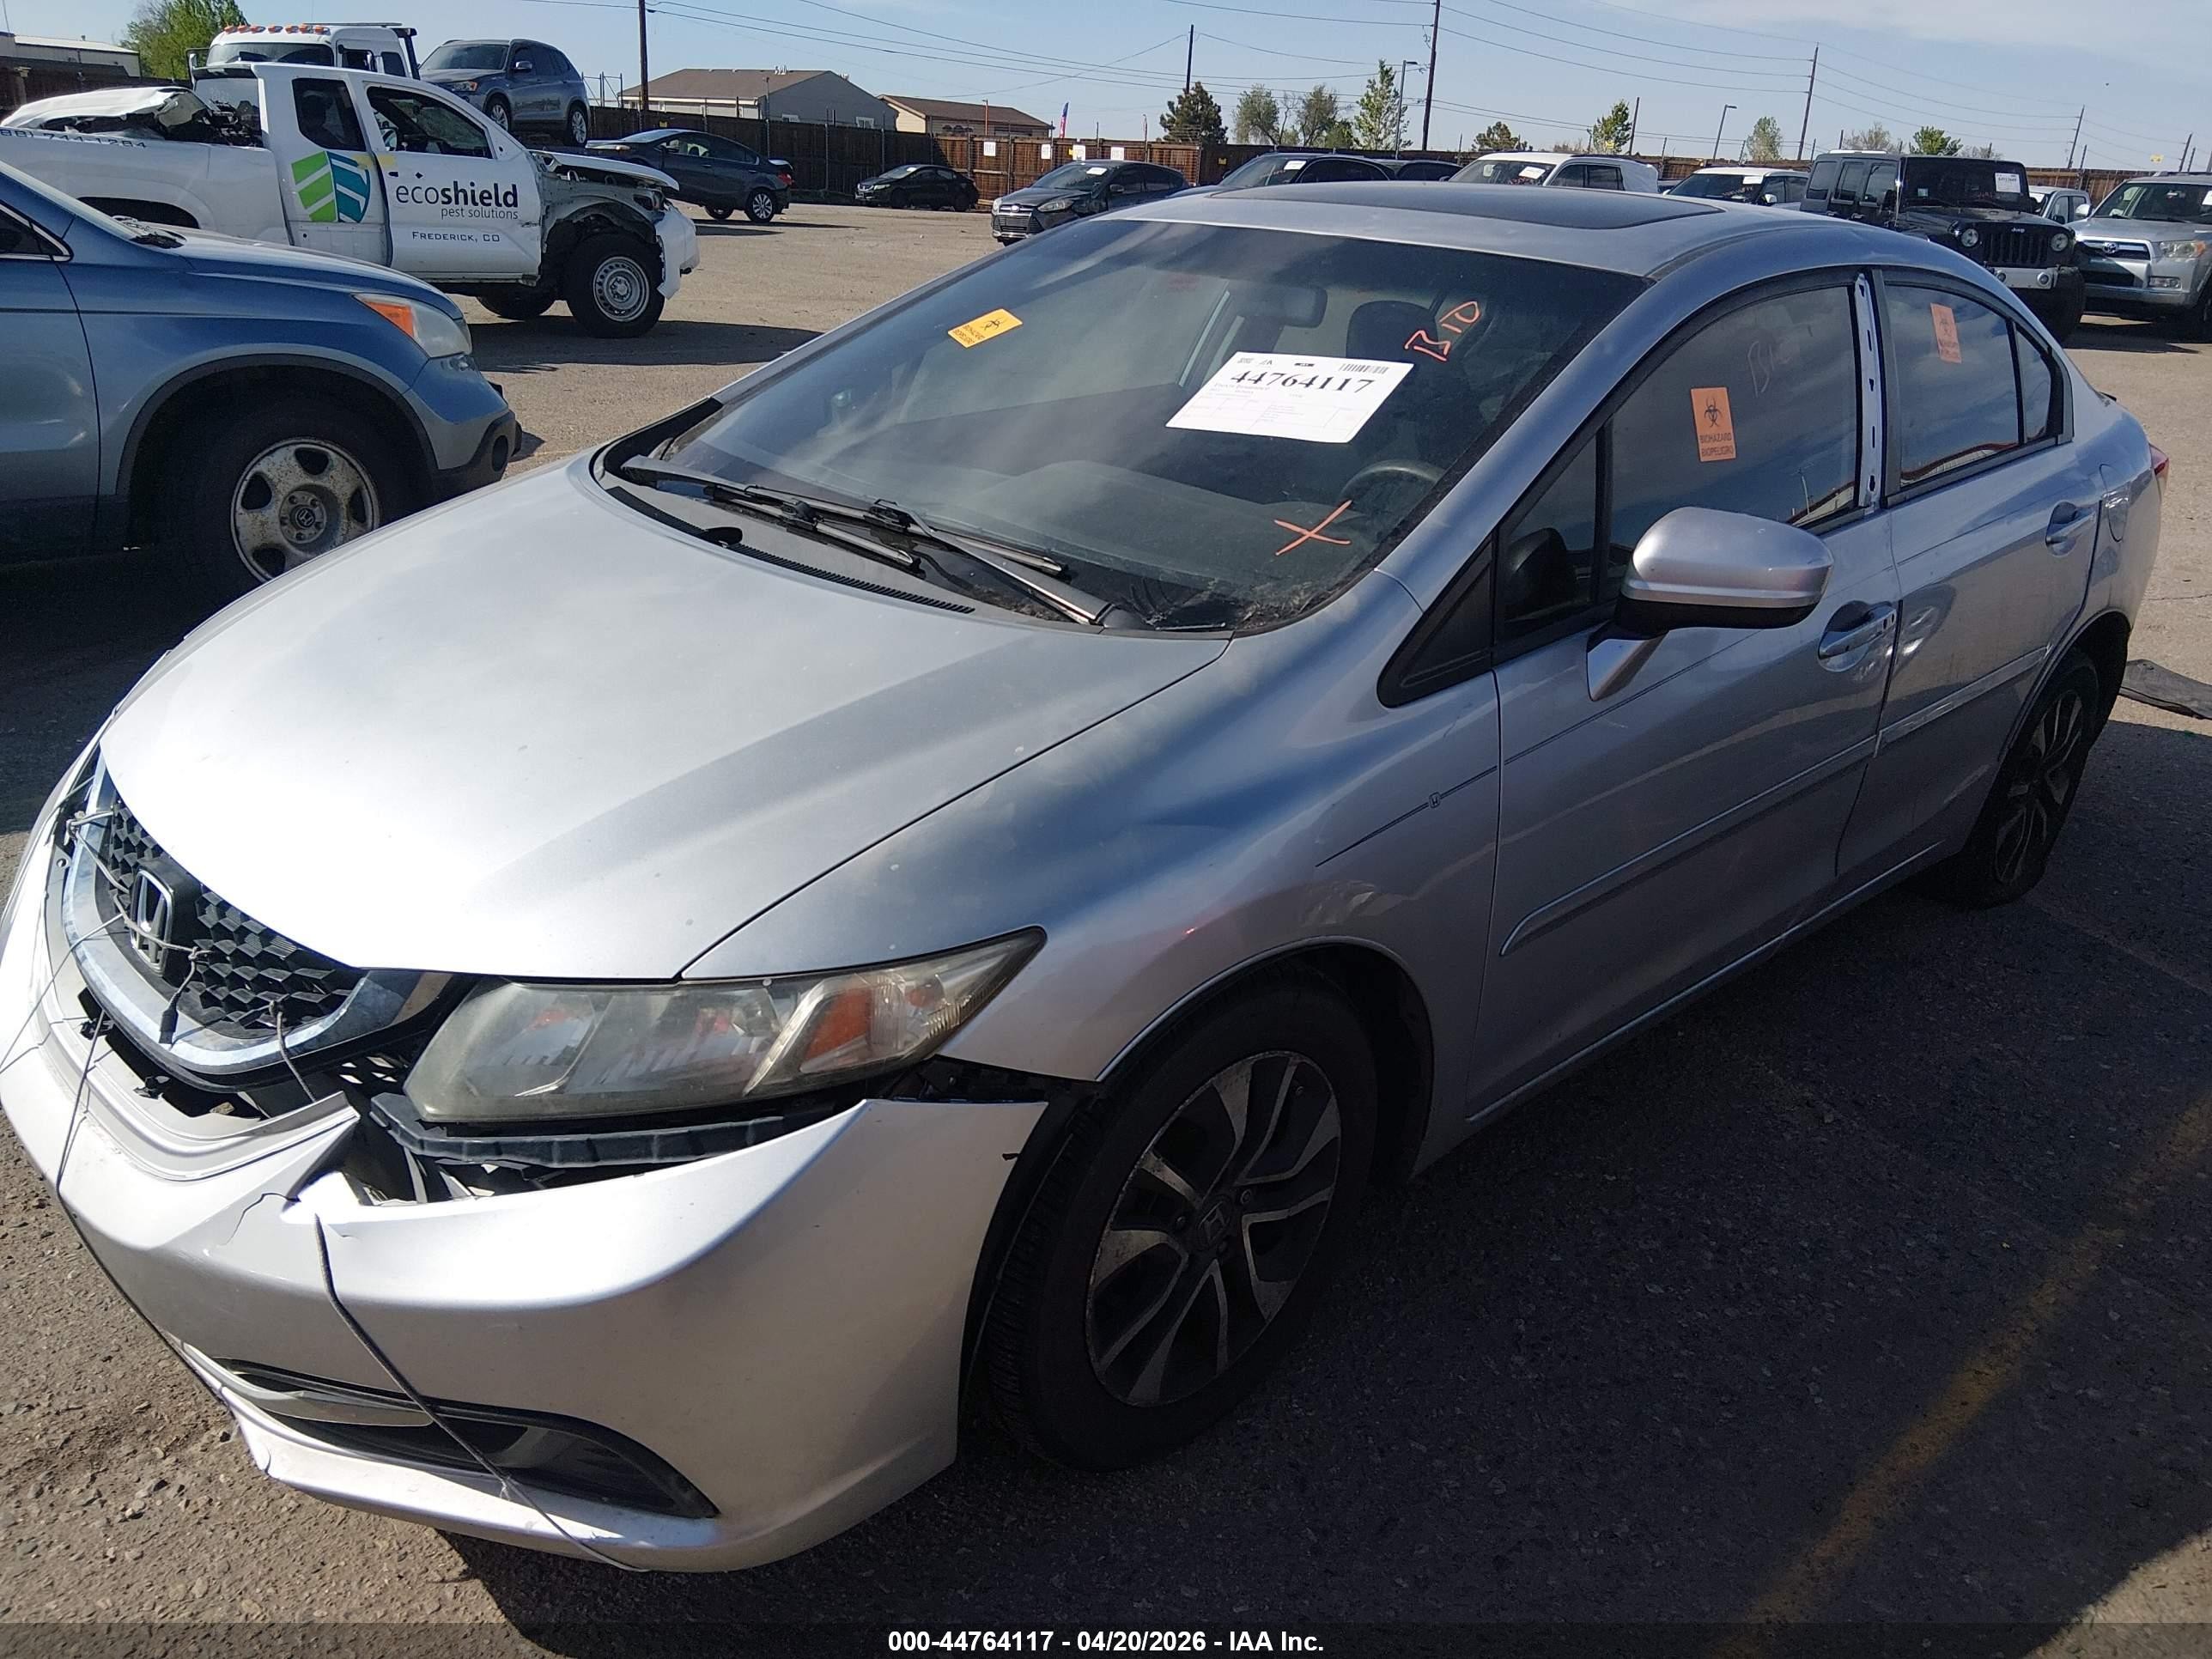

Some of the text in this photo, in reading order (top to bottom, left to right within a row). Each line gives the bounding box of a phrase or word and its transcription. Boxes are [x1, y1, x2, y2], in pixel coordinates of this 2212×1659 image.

[396, 180, 519, 208] ecoshield
[441, 207, 519, 220] pest solutions
[483, 234, 500, 242] CO
[1230, 369, 1376, 394] 44764117
